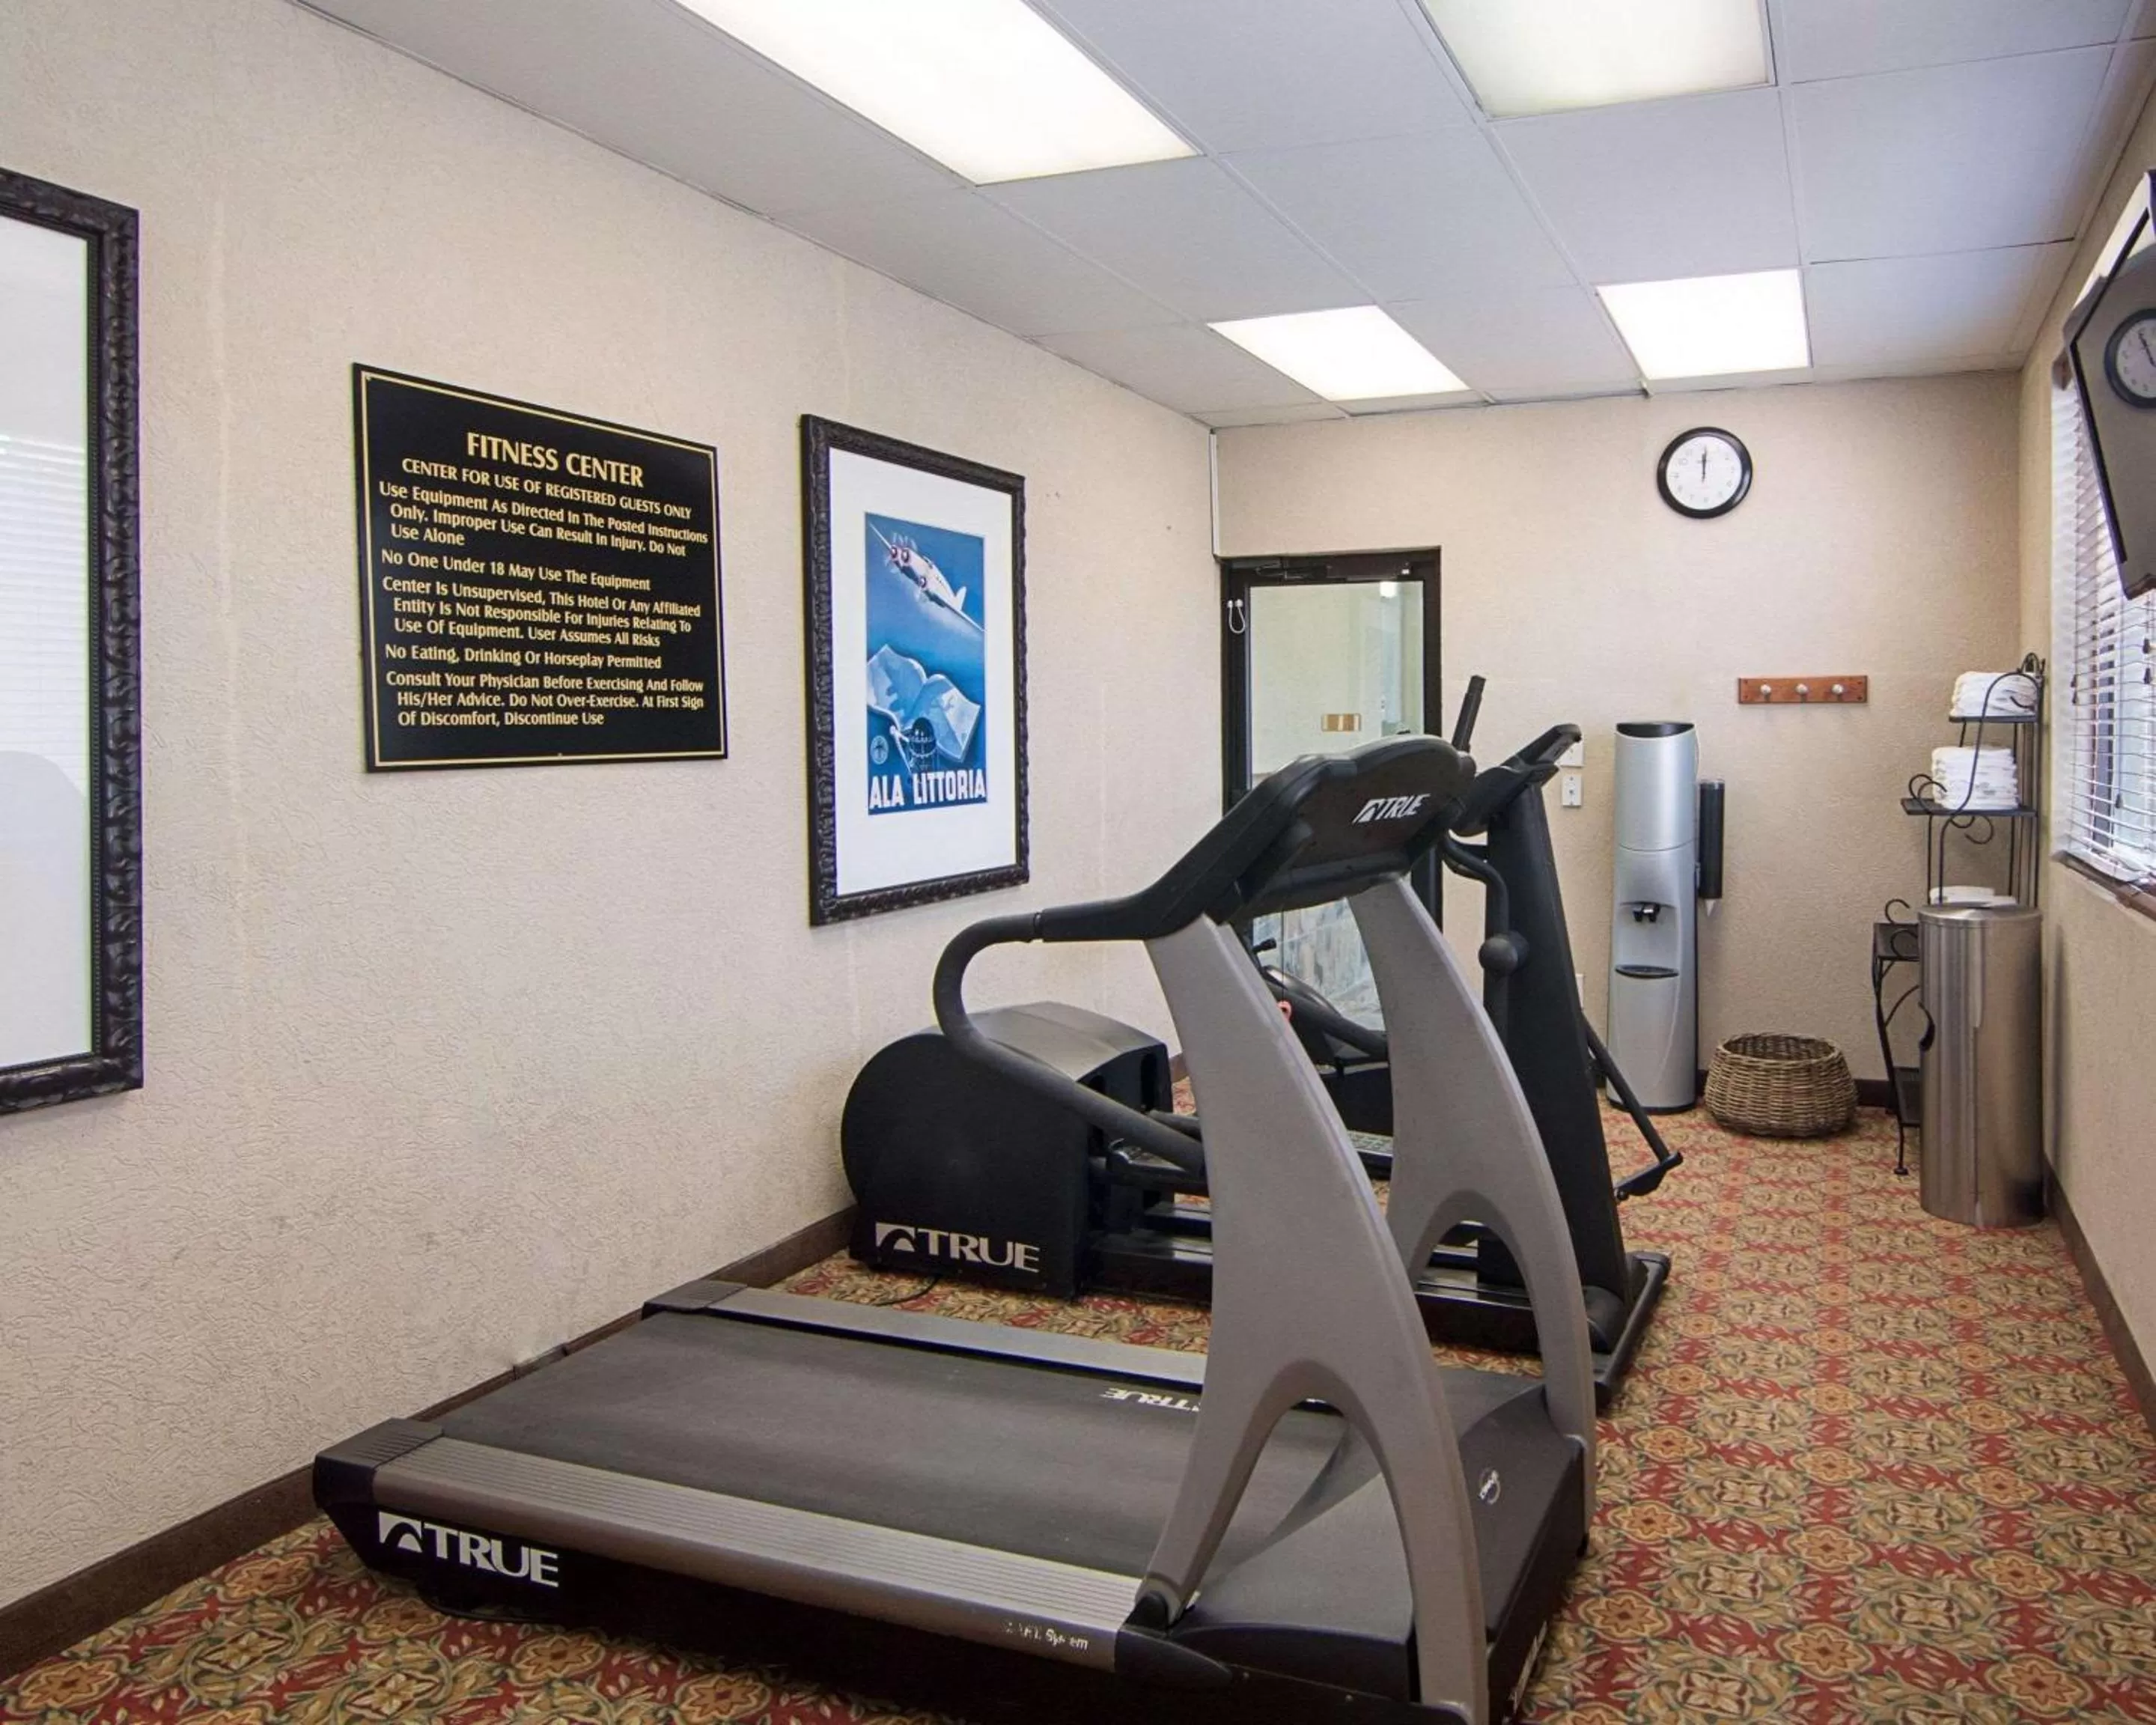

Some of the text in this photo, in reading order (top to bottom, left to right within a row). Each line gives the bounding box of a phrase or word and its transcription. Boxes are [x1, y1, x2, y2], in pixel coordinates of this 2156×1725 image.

[467, 432, 644, 488] FITNESS CENTER
[402, 457, 692, 520] CENTER FOR USE OF REGISTERED GUESTS ONLY
[379, 481, 708, 544] Use Equipment As Directed In The Posted Instructions
[390, 502, 686, 556] Only. Improper Use Can Result In Injury. Do Not
[391, 523, 465, 546] Use Alone
[381, 548, 651, 591] No One Under 18 May Use The Equipment
[382, 576, 432, 594] Center
[436, 581, 448, 596] Is
[549, 591, 575, 606] This
[577, 594, 609, 609] Hotel
[612, 597, 627, 611] Or
[629, 599, 651, 615] Any
[652, 600, 701, 618] Affiliated
[393, 597, 692, 634] Entity Is Not Responsible For Injuries Relating To
[394, 617, 660, 647] Use Of Equipment. User Assumes All Risks
[385, 643, 407, 659] No
[464, 648, 522, 666] Drinking
[524, 651, 541, 664] Or
[544, 651, 604, 669] Horseplay
[607, 654, 662, 669] Permitted
[386, 670, 704, 693] Consult Your Physician Before Exercising And Follow
[397, 691, 453, 708] His/Her
[457, 691, 505, 707] Advice.
[509, 693, 528, 707] Do
[531, 693, 553, 707] Not
[642, 696, 654, 708] At
[657, 695, 679, 708] First
[681, 696, 704, 711] Sign
[398, 711, 417, 726] Of
[504, 711, 579, 725] Discontinue
[582, 712, 604, 725] Use
[870, 769, 986, 809] ALA LITTORIA
[1374, 793, 1431, 821] TRUE
[917, 1228, 1040, 1273] TRUE
[1099, 1387, 1191, 1411] TRUE
[423, 1522, 559, 1588] TRUE
